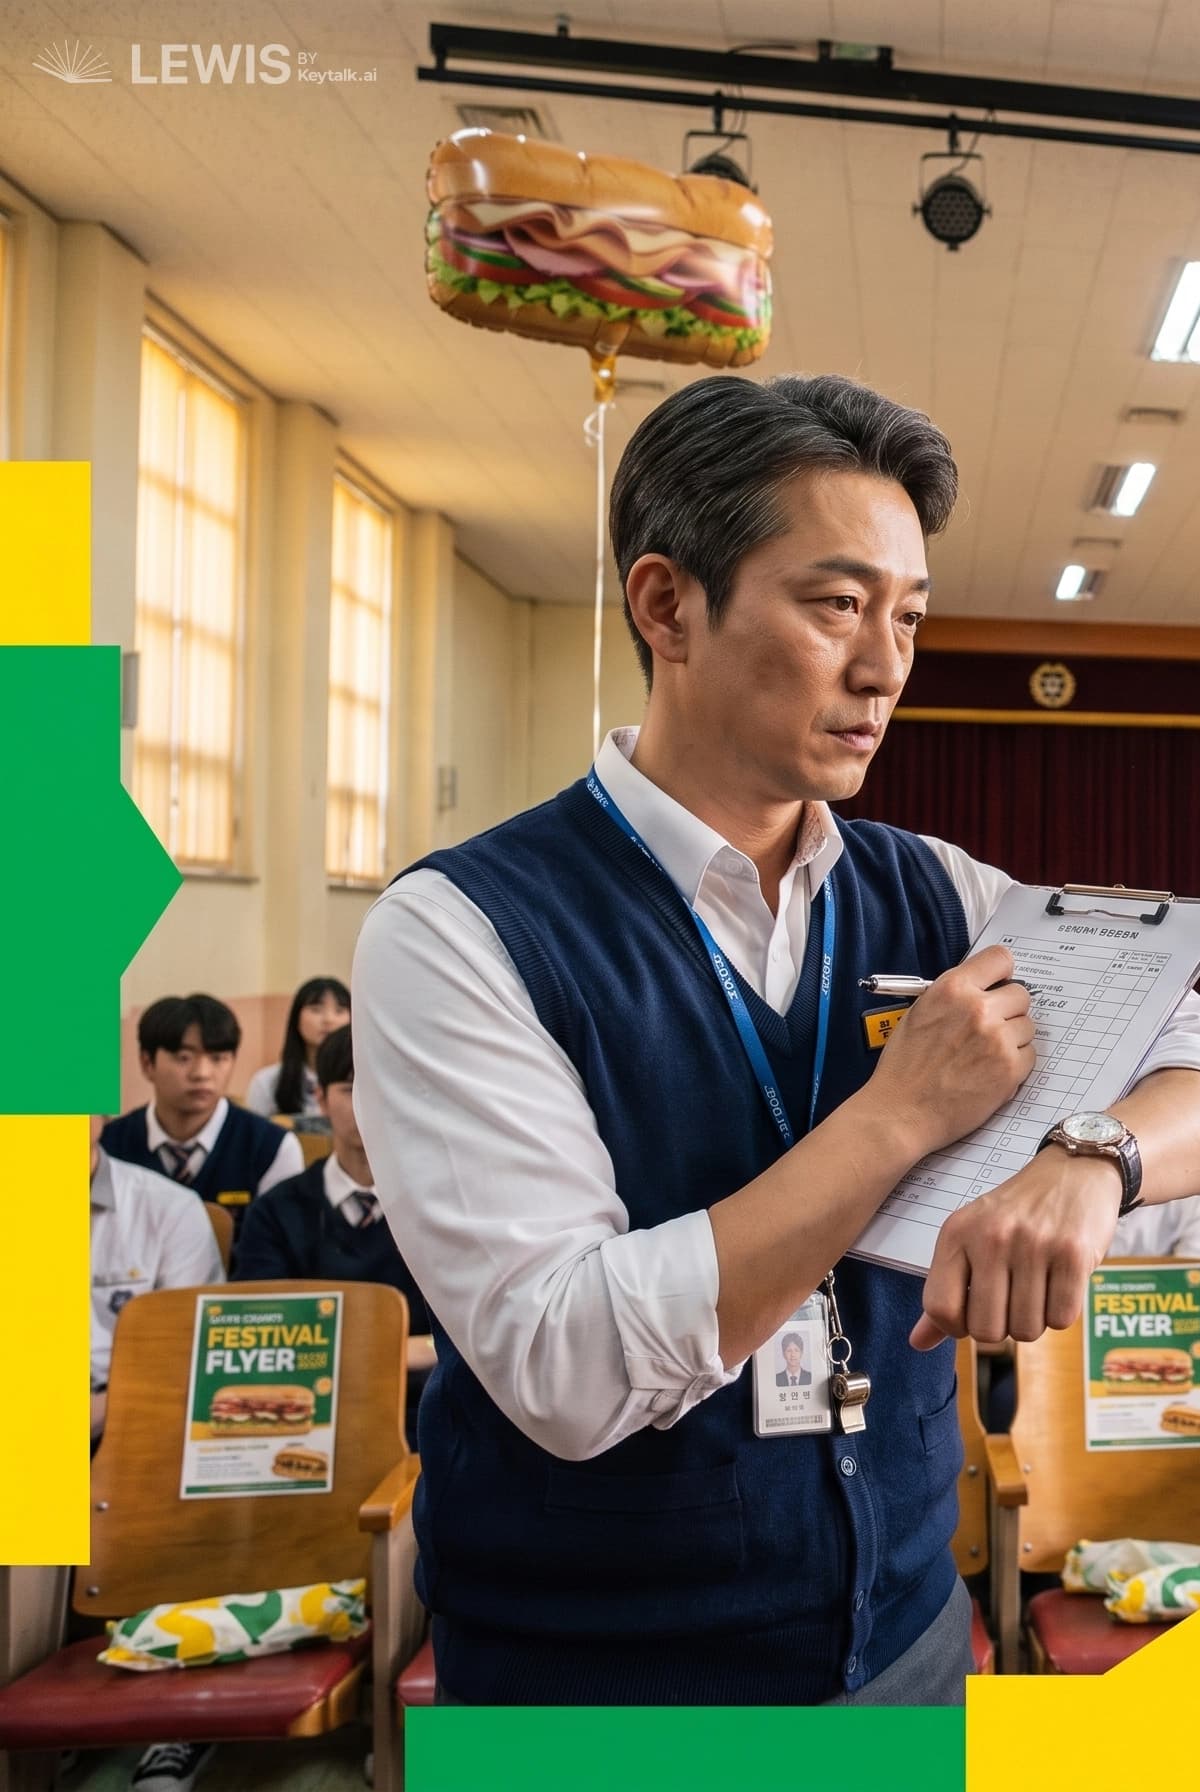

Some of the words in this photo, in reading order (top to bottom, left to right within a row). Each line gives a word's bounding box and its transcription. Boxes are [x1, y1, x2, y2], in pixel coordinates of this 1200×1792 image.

[1094, 1293, 1200, 1314] FESTIVAL
[207, 1323, 329, 1349] FESTIVAL
[1094, 1314, 1172, 1338] FLYER
[205, 1348, 295, 1375] FLYER
